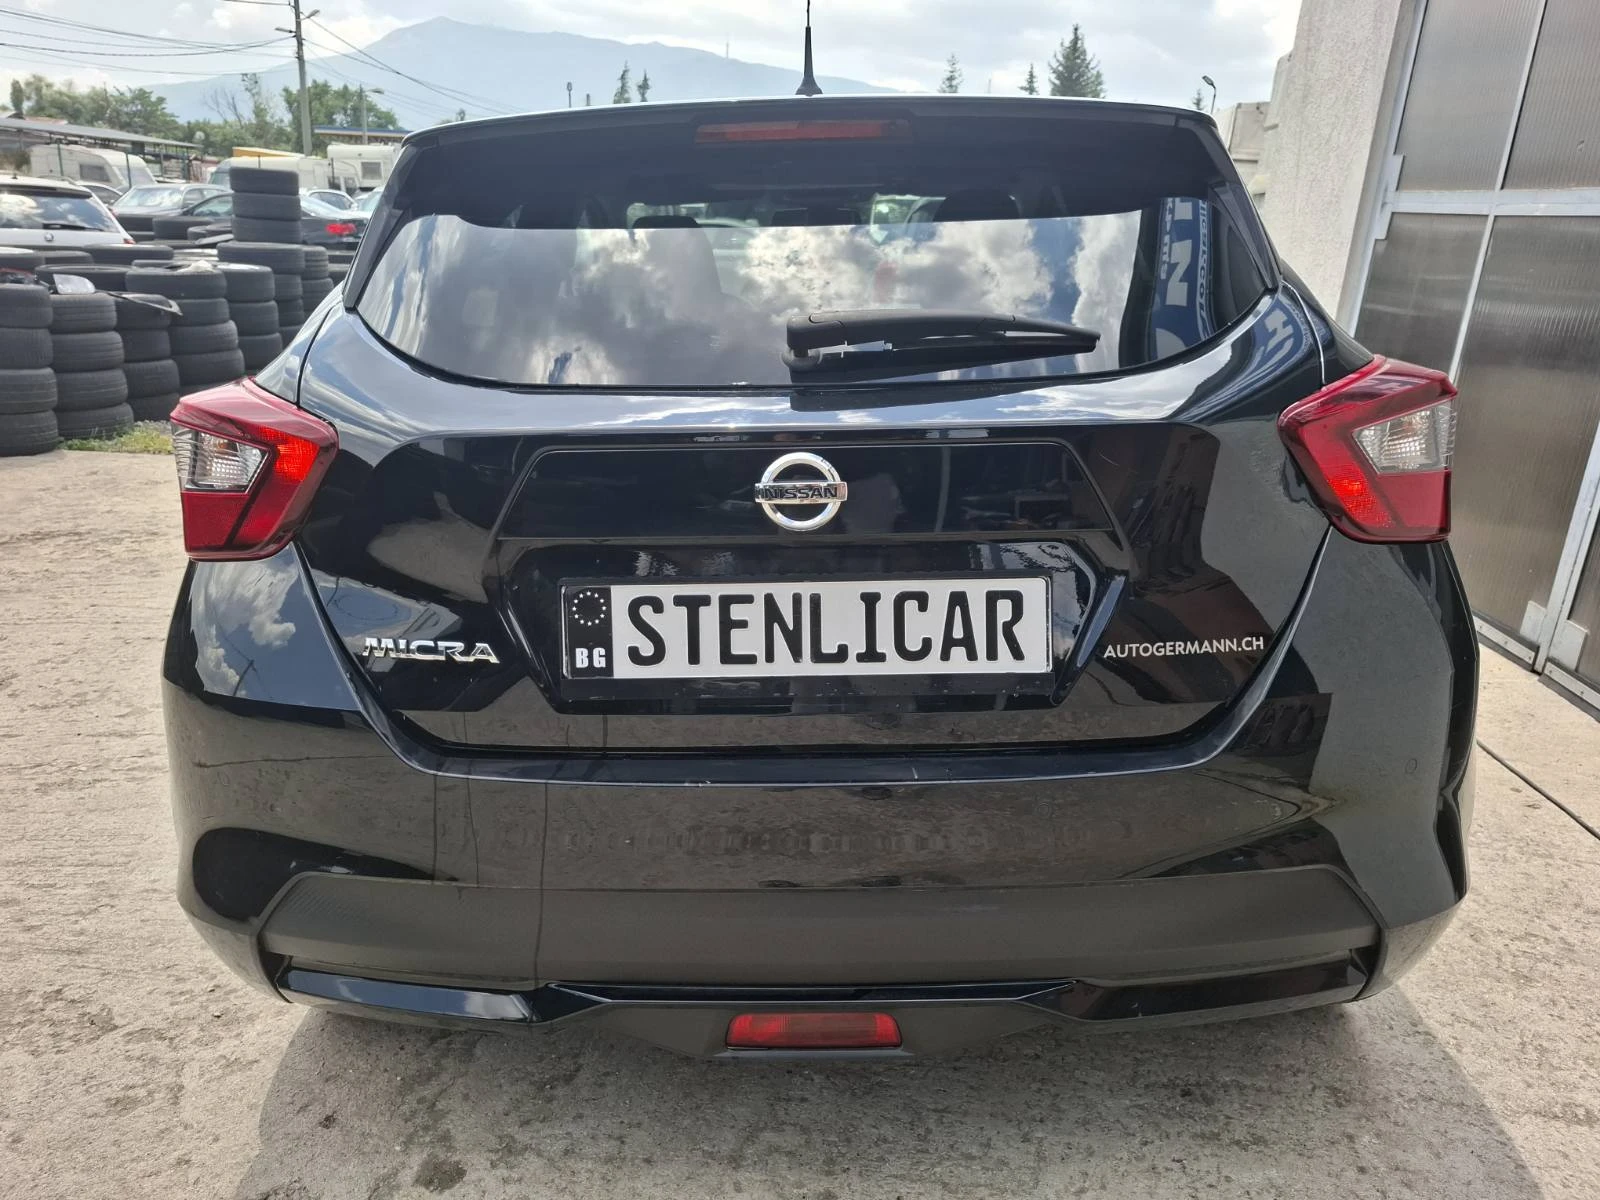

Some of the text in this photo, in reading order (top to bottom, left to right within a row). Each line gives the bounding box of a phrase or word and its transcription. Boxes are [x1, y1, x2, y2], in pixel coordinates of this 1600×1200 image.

[764, 486, 838, 499] NISSAN
[627, 590, 1025, 666] STENLICAR
[362, 637, 500, 664] MICRA
[575, 647, 606, 669] BG
[1103, 636, 1264, 658] AUTOGERMANN.CH
